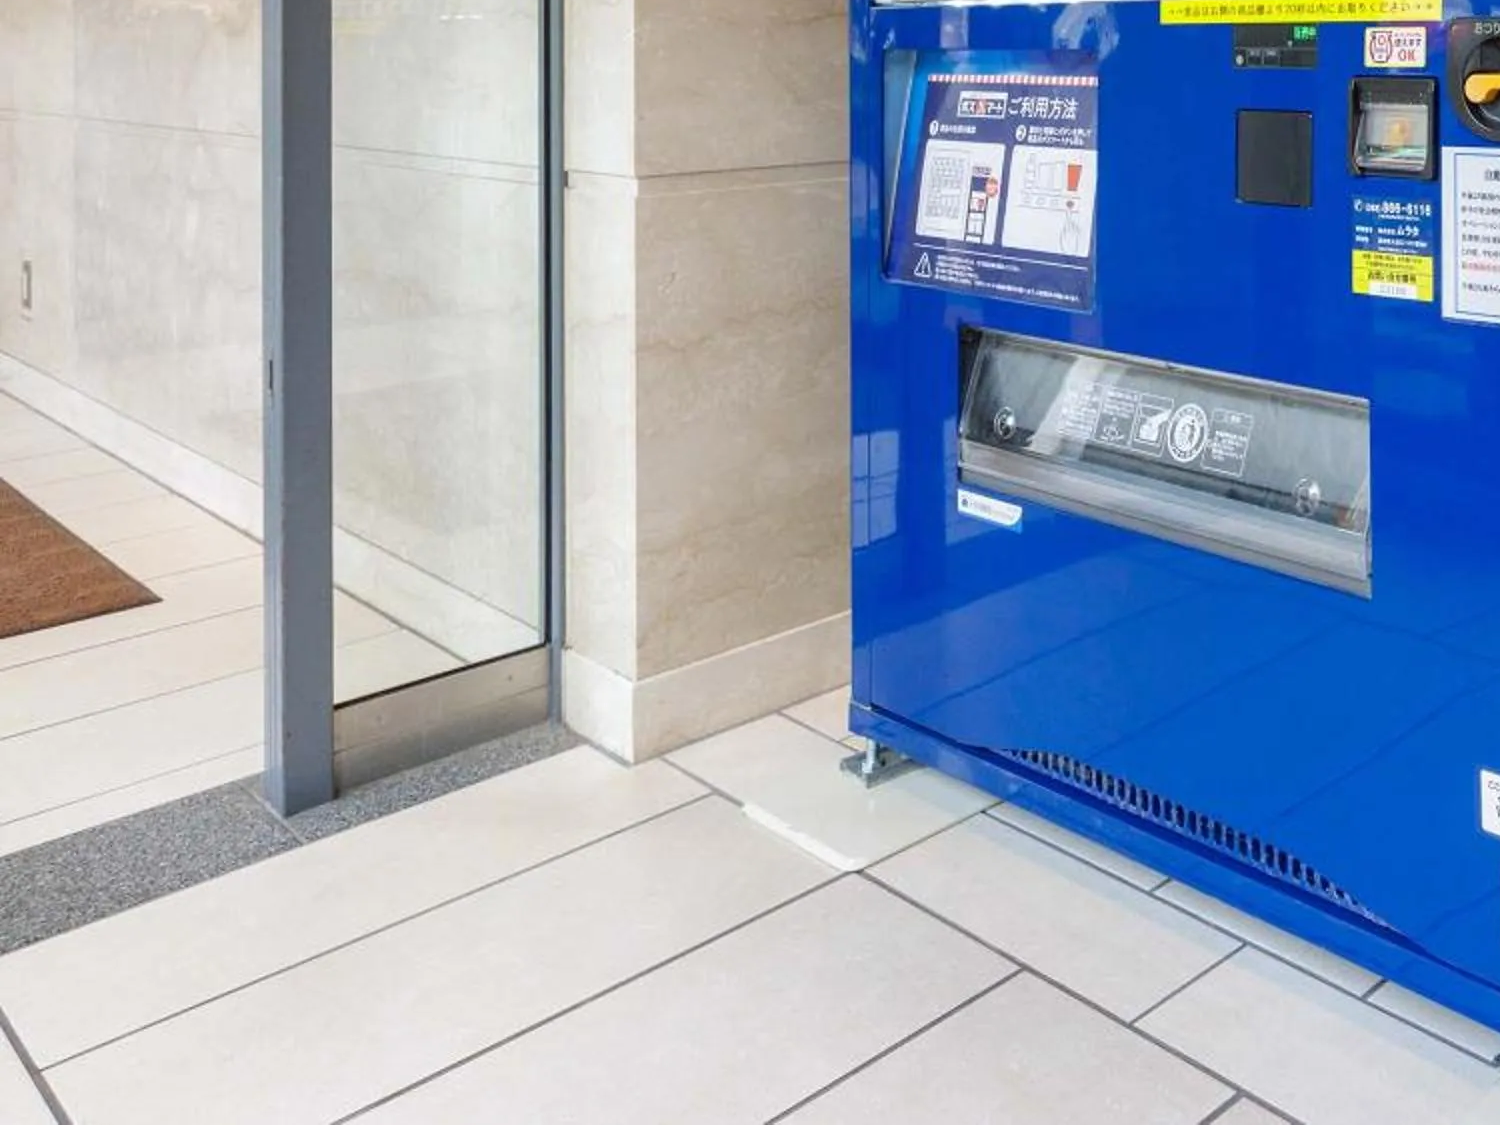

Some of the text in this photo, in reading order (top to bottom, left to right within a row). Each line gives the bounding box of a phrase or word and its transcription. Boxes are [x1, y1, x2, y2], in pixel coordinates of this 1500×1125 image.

[1007, 94, 1079, 120] ご利用方法
